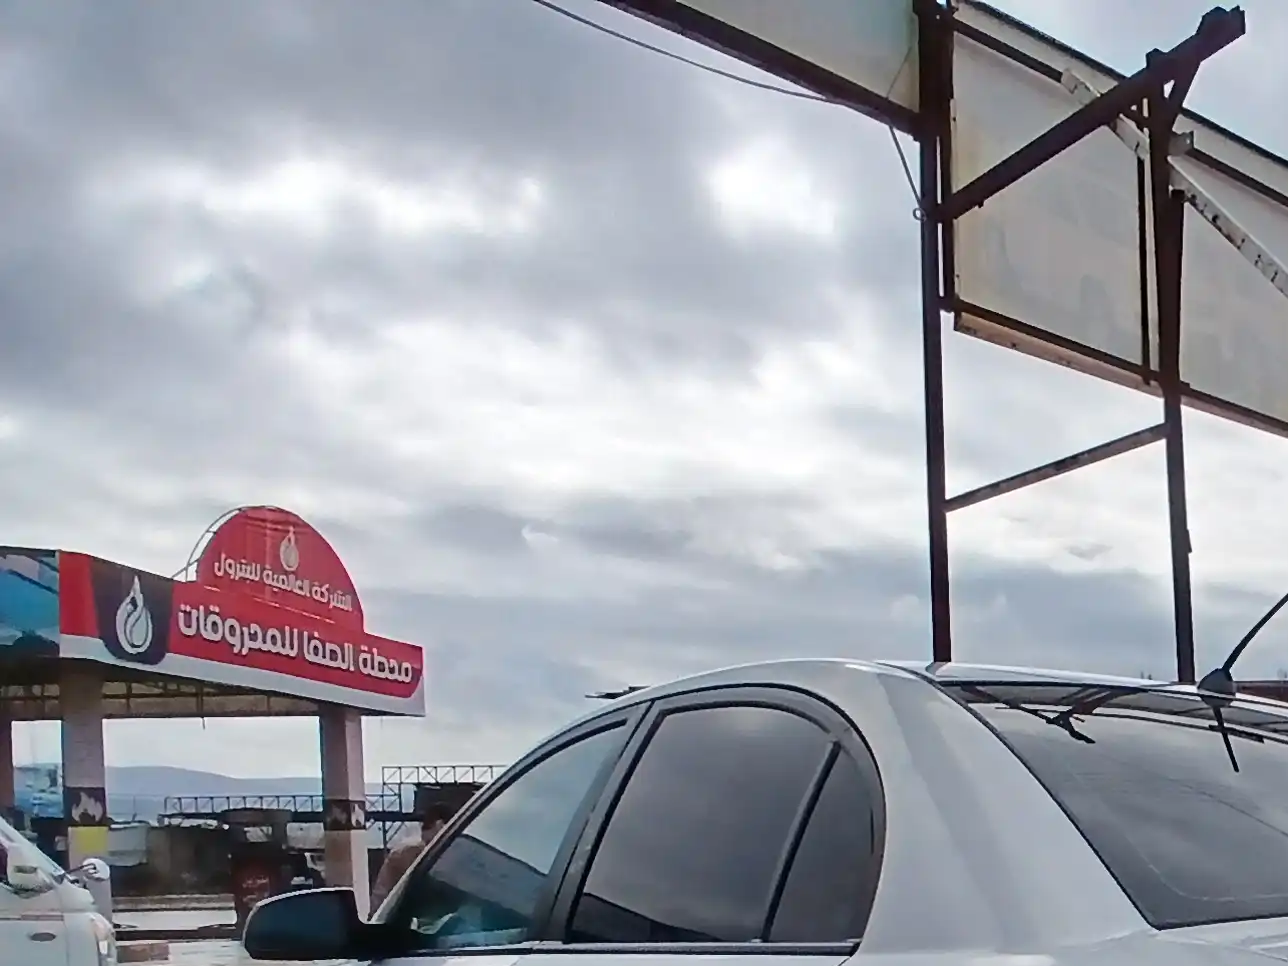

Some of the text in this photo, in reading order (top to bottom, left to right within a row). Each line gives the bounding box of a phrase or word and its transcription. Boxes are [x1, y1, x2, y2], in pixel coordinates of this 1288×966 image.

[178, 603, 412, 683] محطة الصفا للمحروقات
